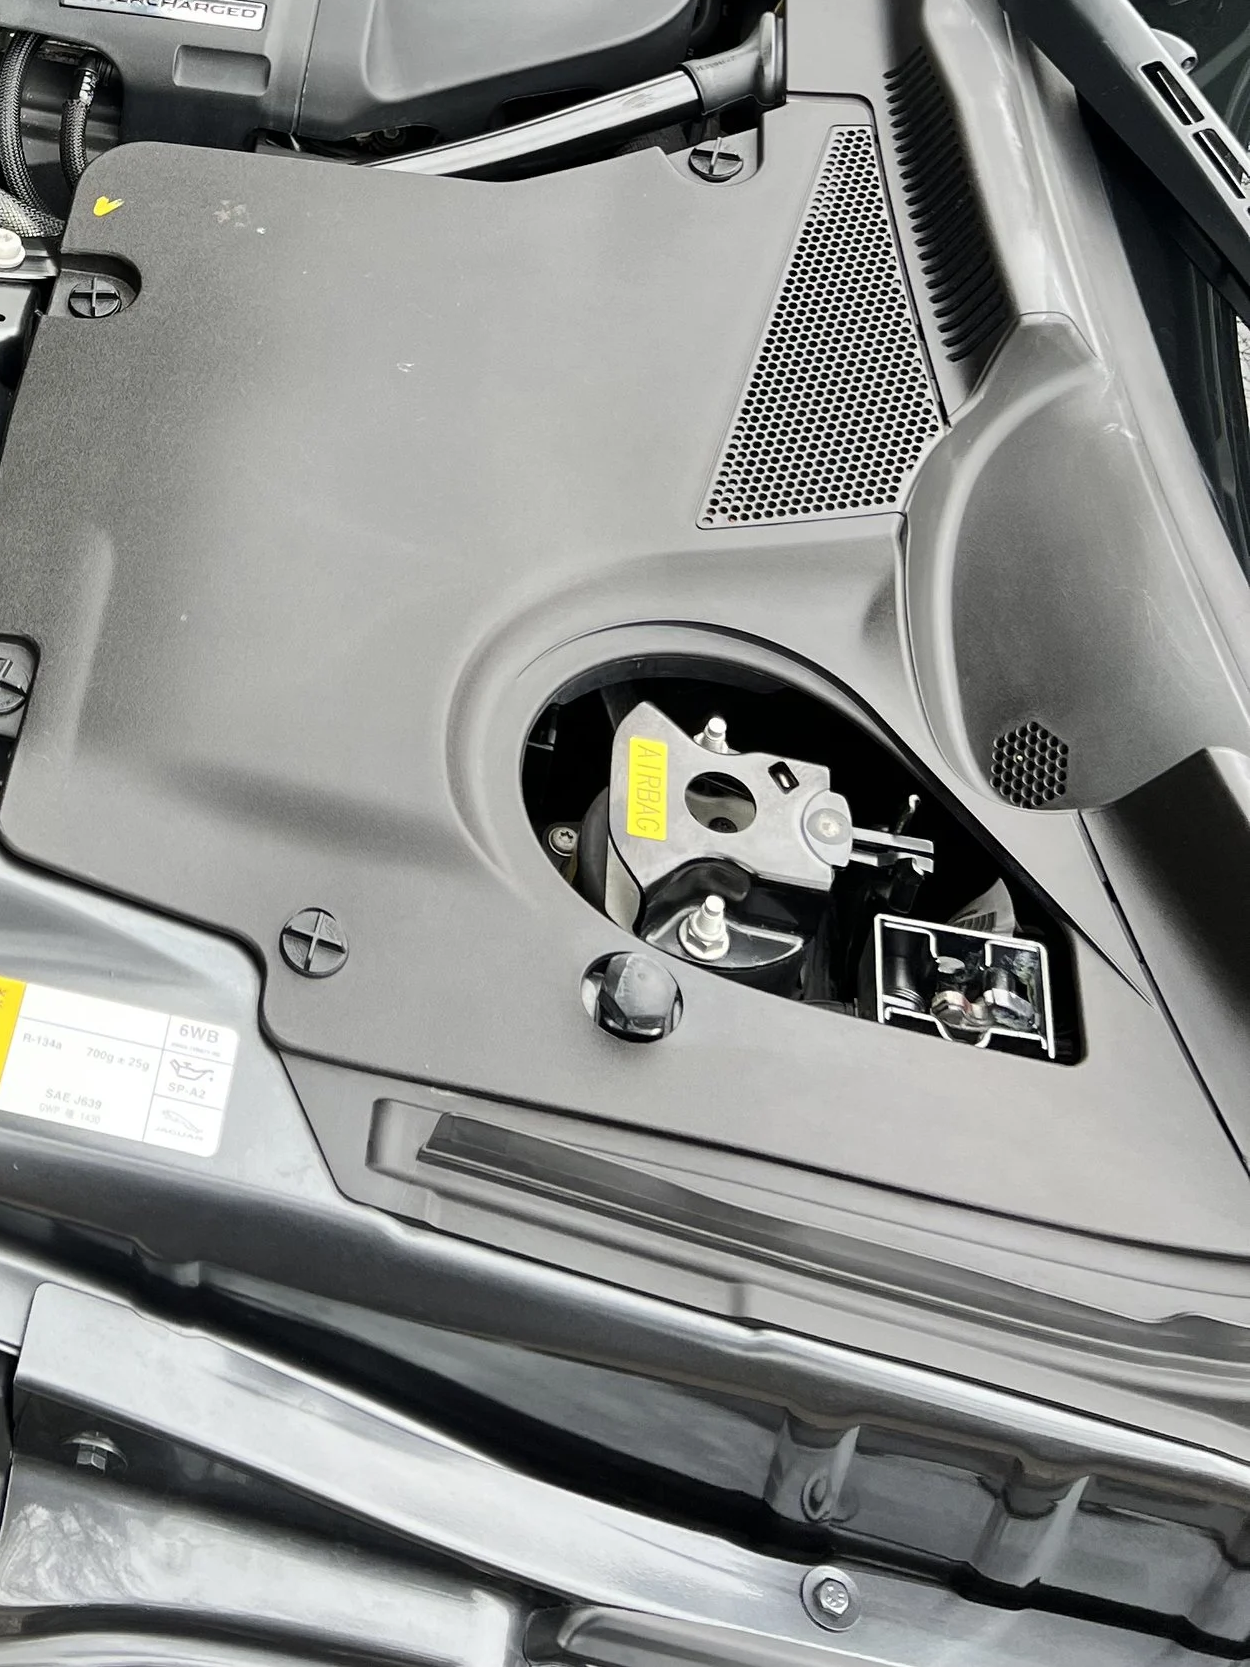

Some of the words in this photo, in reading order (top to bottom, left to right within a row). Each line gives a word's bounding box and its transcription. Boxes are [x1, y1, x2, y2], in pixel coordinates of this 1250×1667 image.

[635, 743, 663, 833] AIRBAG
[179, 1024, 220, 1044] 6WB
[22, 1033, 63, 1050] R-134a
[86, 1046, 114, 1064] 700g
[128, 1057, 150, 1072] 25g
[45, 1088, 70, 1103] SAE
[73, 1096, 102, 1110] J639
[168, 1082, 206, 1100] SP-A2
[154, 1125, 204, 1142] JAGUAR
